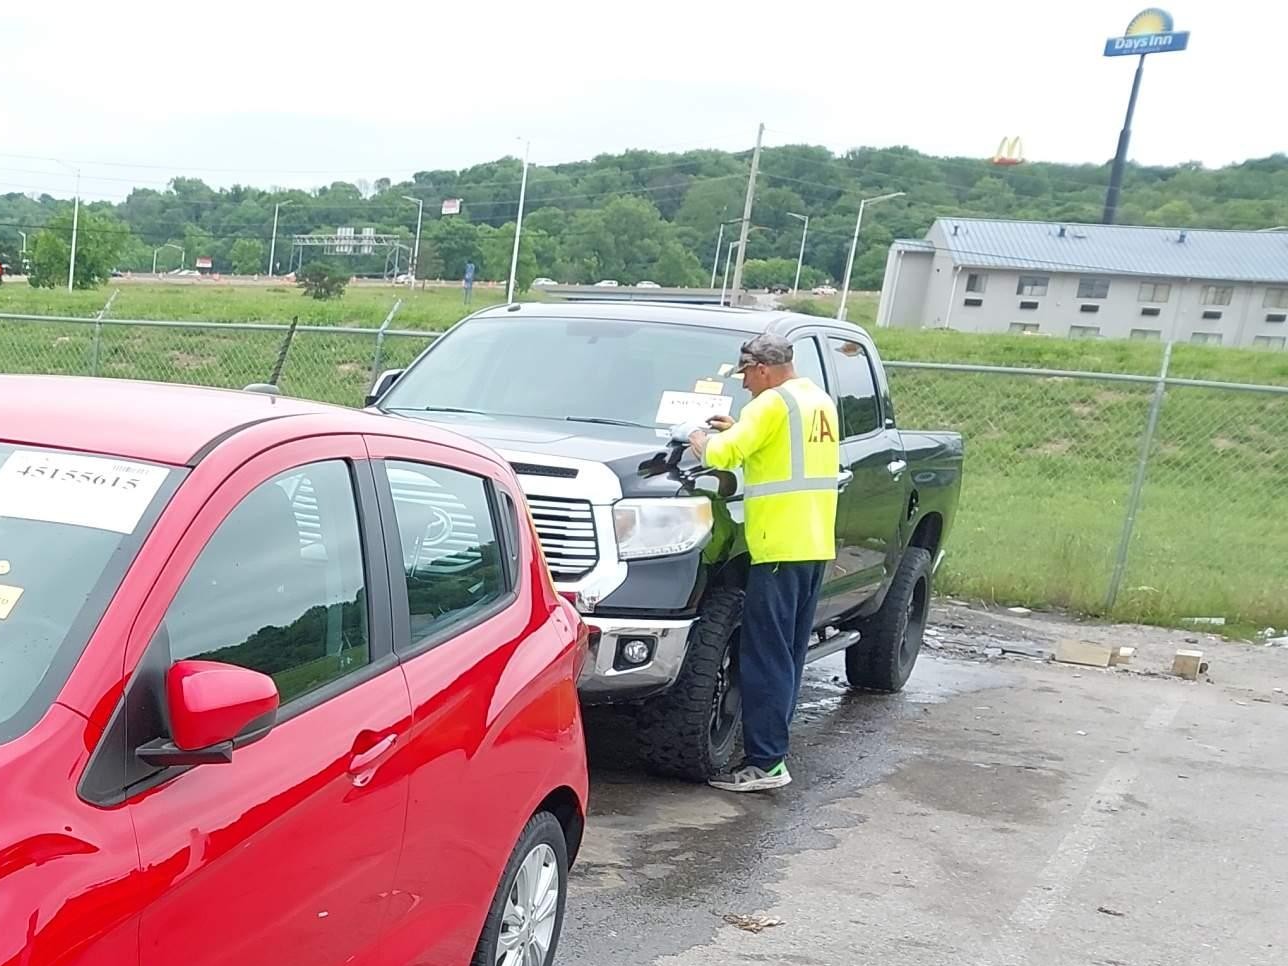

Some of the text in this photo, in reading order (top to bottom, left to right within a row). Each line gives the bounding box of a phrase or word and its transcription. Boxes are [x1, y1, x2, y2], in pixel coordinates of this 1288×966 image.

[1114, 35, 1173, 49] Days Inn
[16, 464, 140, 490] 45155615
